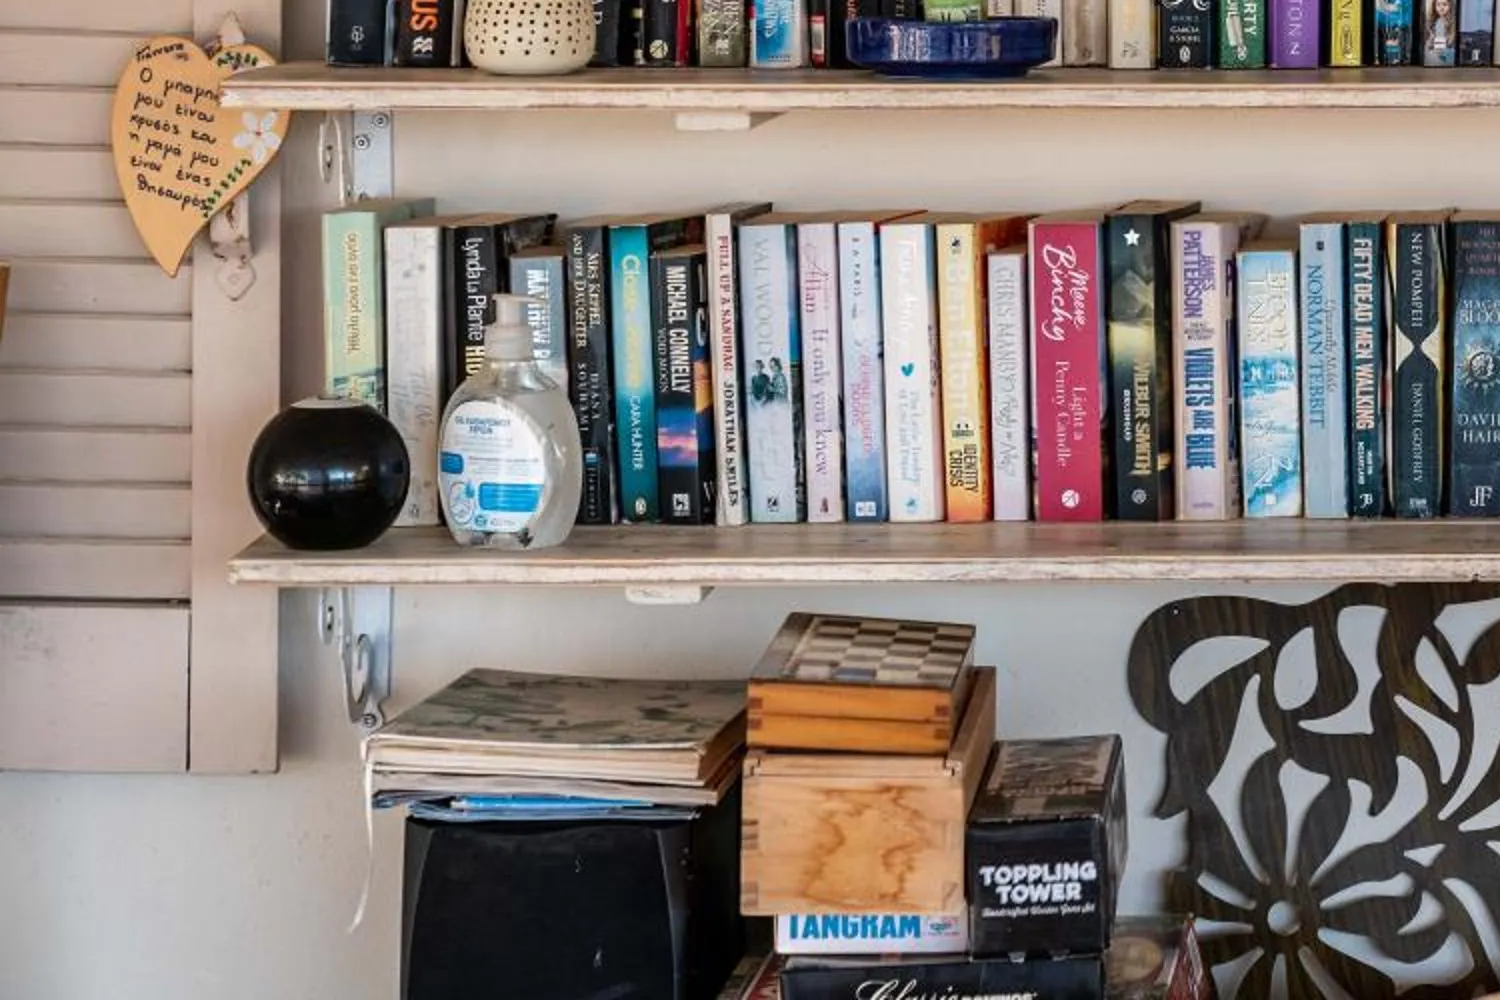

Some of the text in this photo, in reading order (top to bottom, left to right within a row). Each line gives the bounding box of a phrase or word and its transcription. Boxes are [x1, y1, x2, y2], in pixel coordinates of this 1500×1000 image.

[189, 151, 219, 169] μου
[463, 236, 489, 340] Lynda Plante
[587, 251, 601, 328] MRS KEPPEL
[718, 234, 734, 373] PULL UP SANDBAG
[851, 262, 862, 298] PARIS
[995, 266, 1017, 317] CHRIS
[1040, 243, 1079, 343] Binchy
[1069, 269, 1091, 329] Maeve
[1183, 230, 1204, 319] PATTERSON
[1202, 254, 1216, 292] JAMES
[1410, 231, 1424, 328] NEW POMPEII
[573, 280, 588, 349] DAUGHTER
[665, 265, 693, 394] MICHAEL CONNELLY
[754, 288, 775, 358] WOOD
[1305, 263, 1326, 430] NORMAN TEBBIT
[1353, 236, 1376, 431] FIFTY DEAD MEN WALKING
[657, 327, 669, 394] VOID MOON
[578, 362, 588, 431] SOUHAMI
[723, 380, 738, 453] JONATHAN
[811, 346, 831, 477] only you knew
[1051, 360, 1071, 467] Penny Candle
[1070, 385, 1089, 430] Light
[1129, 360, 1153, 476] WILBUR SMITH
[1184, 346, 1216, 471] VIOLETS ARE BLUE
[631, 427, 646, 472] HUNTER
[949, 450, 965, 487] CRISIS
[962, 443, 979, 494] IDENTITY
[1411, 382, 1424, 484] DANIEL GODFREY
[978, 860, 1098, 888] TOPPLING
[994, 882, 1083, 905] TOWER
